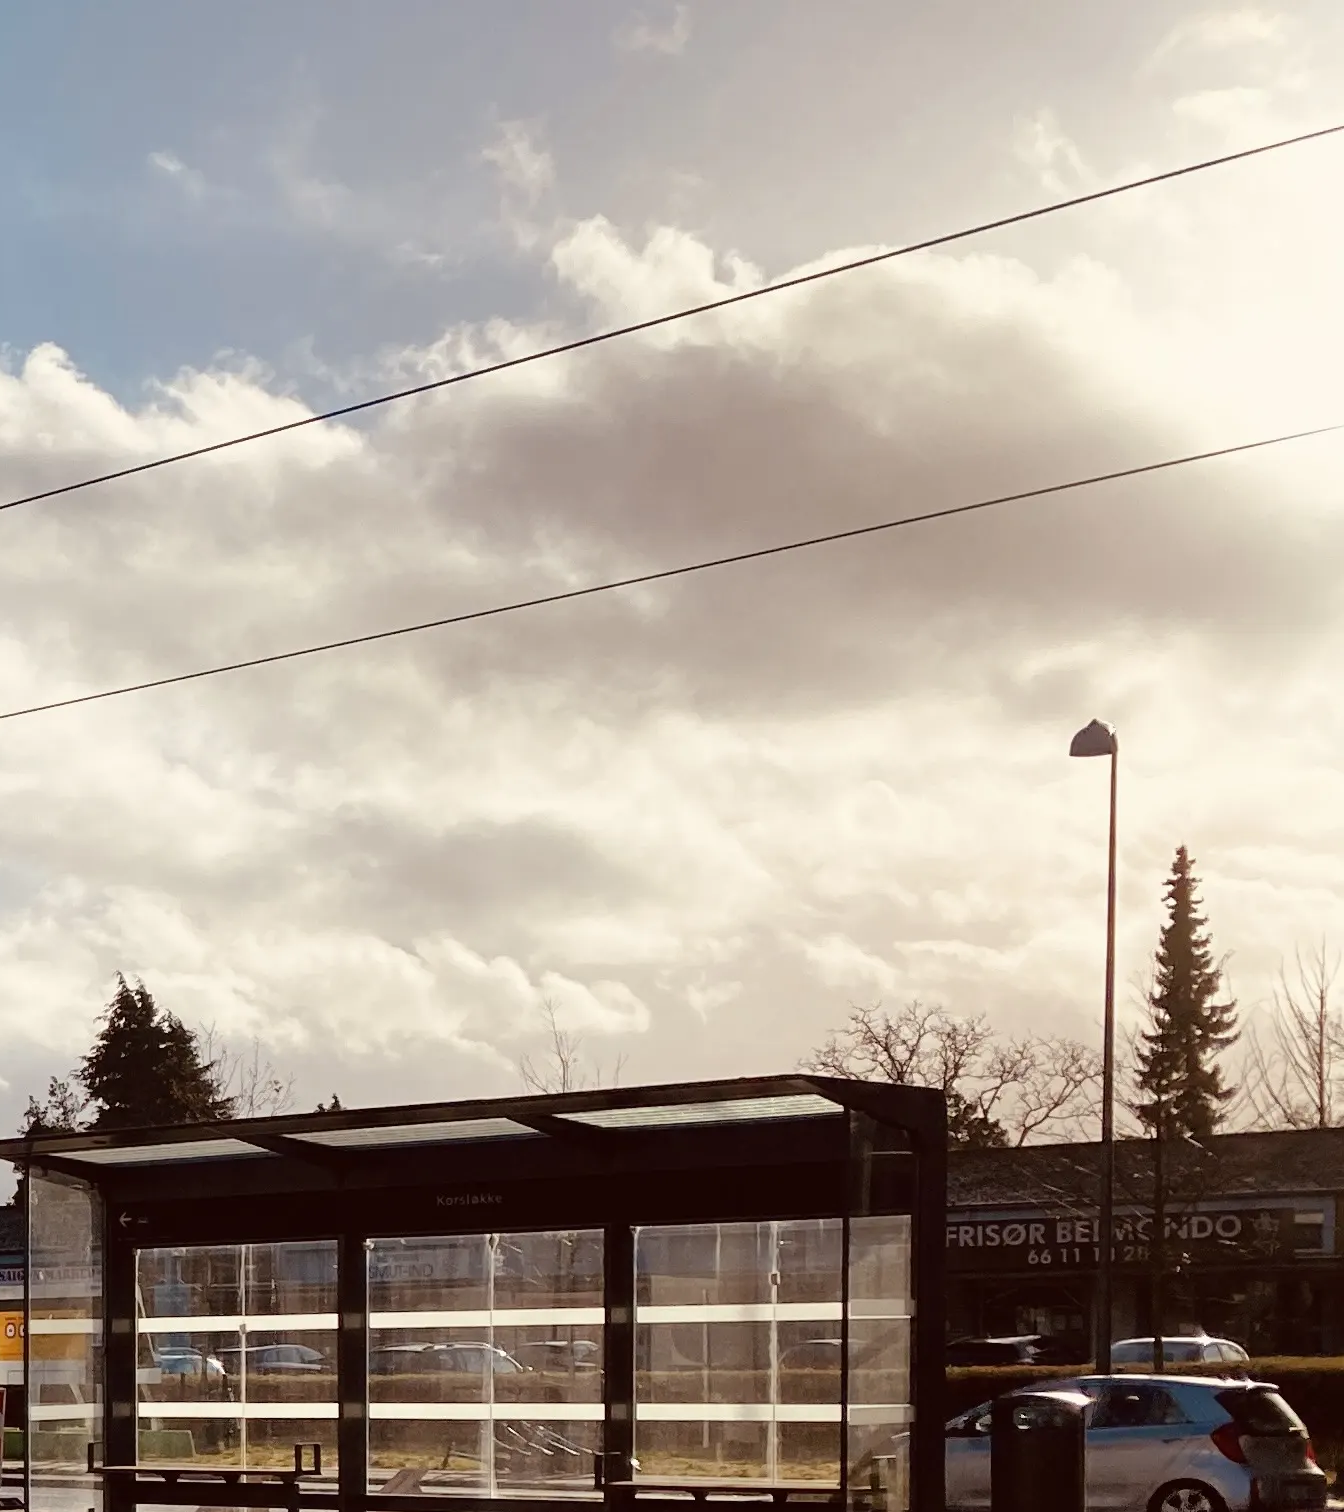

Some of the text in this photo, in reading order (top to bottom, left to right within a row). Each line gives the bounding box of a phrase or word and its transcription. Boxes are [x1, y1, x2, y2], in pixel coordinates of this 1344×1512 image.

[436, 1194, 503, 1206] Korsløkke
[946, 1223, 1046, 1247] FRISØR
[1027, 1249, 1052, 1265] 66
